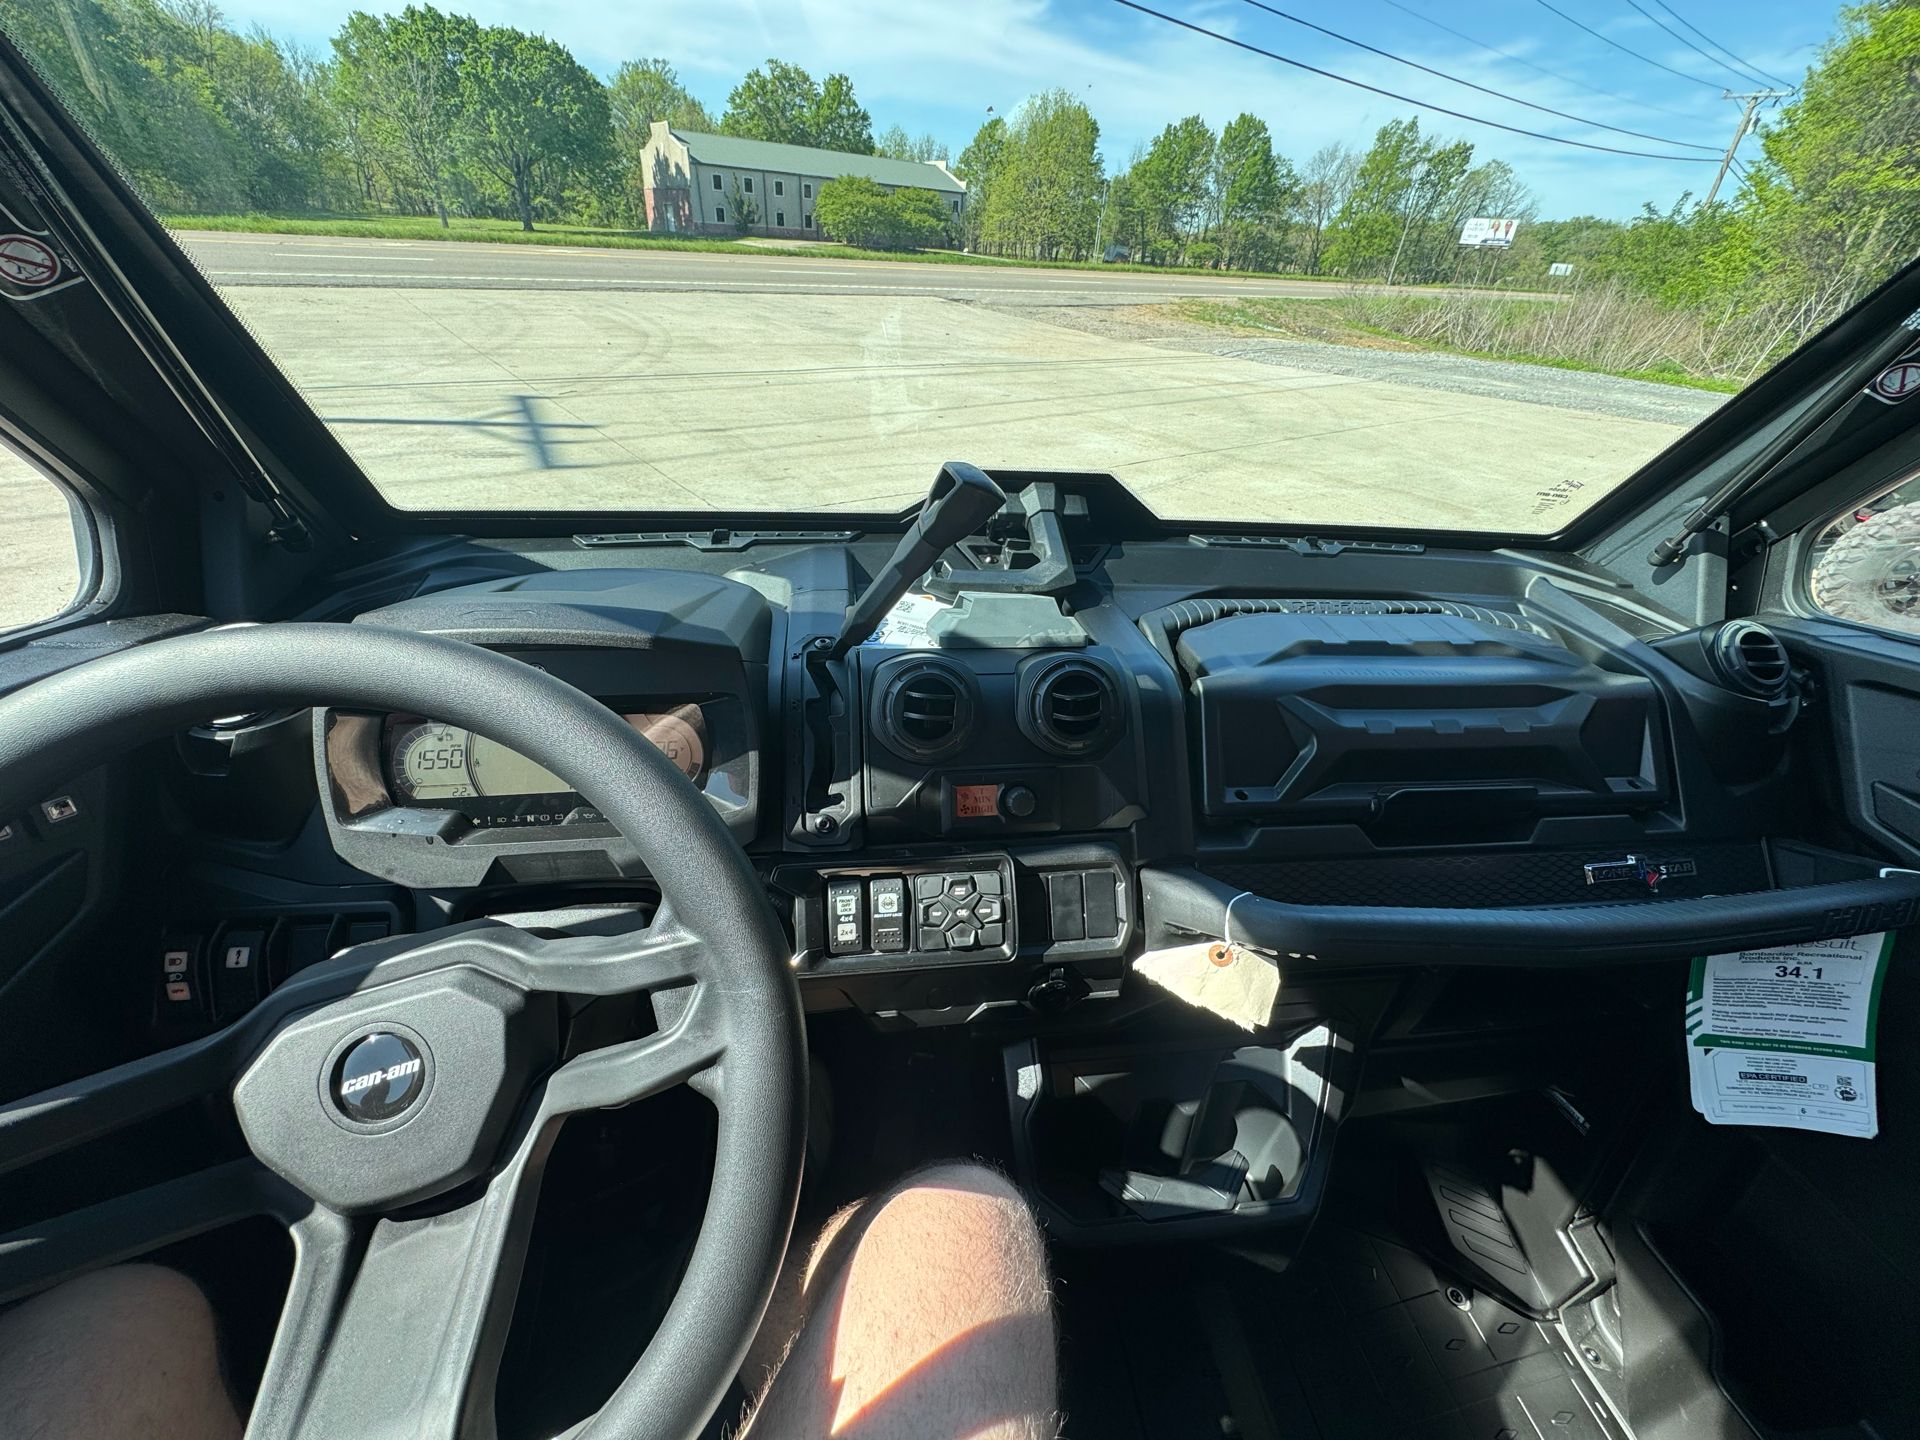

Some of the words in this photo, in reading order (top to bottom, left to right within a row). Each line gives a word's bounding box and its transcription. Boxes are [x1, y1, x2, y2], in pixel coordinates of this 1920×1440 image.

[418, 749, 463, 770] 1550
[452, 787, 467, 796] 2.2
[1660, 862, 1693, 873] STAR
[1797, 952, 1863, 961] Recreational
[1775, 965, 1824, 980] 34.1
[341, 1059, 420, 1095] can-am
[1741, 1072, 1758, 1080] EPA
[1759, 1073, 1806, 1083] CERTIFIED
